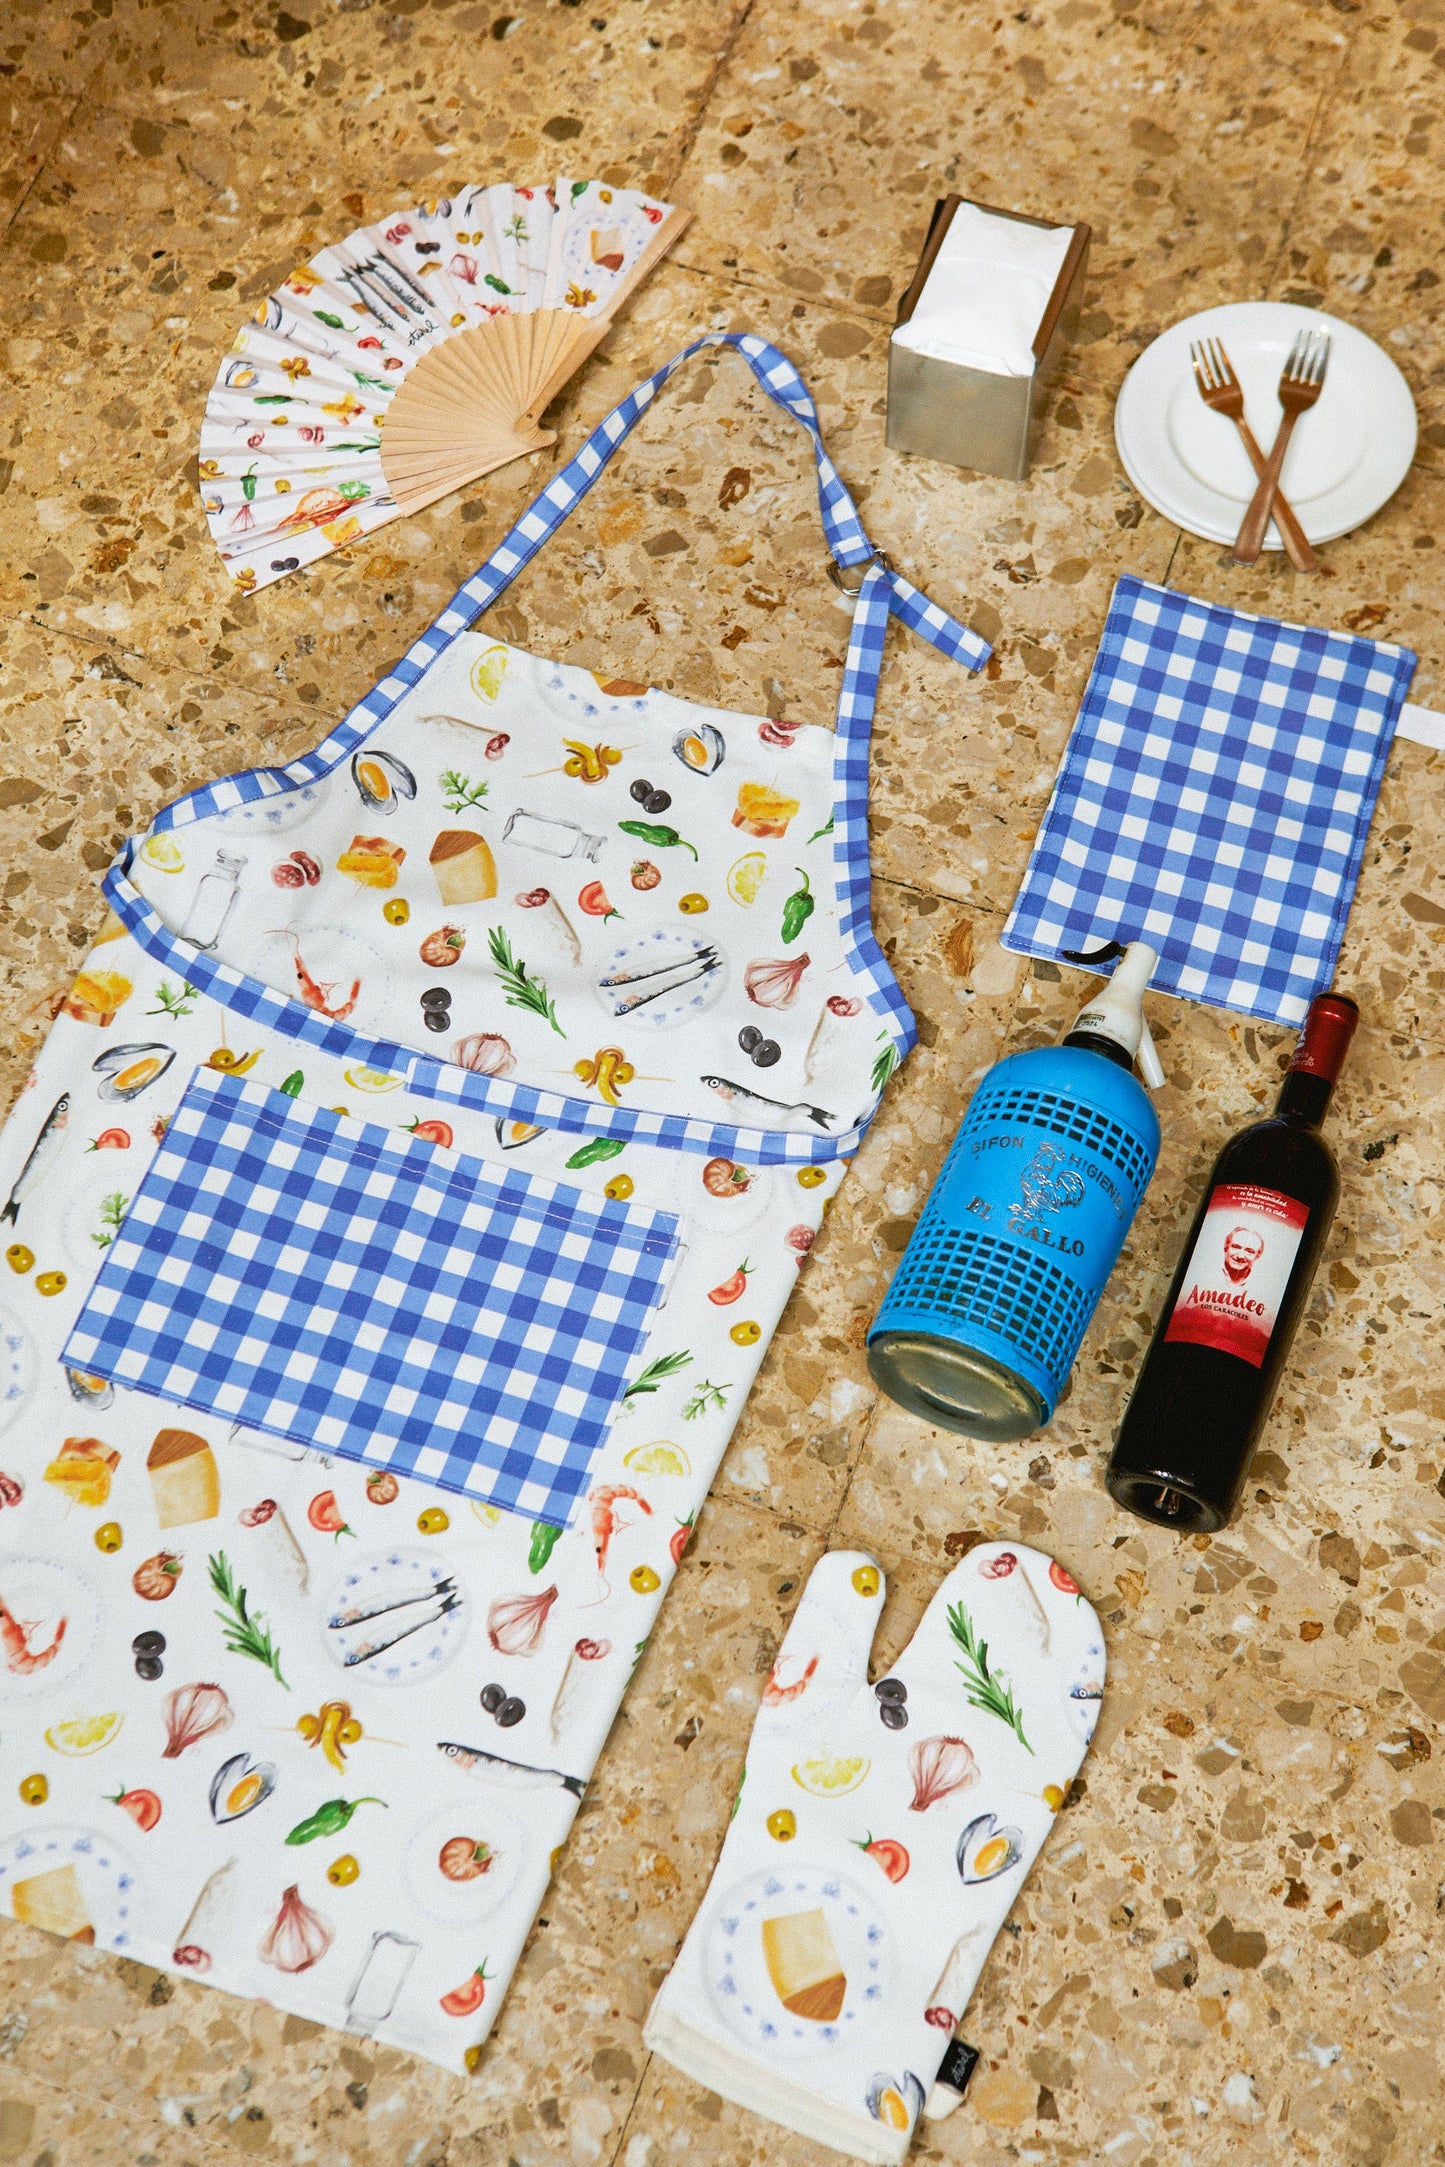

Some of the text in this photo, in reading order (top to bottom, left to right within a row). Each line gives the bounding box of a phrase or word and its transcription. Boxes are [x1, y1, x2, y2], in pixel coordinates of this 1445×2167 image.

[971, 1135, 1025, 1154] SIFON
[965, 1195, 1085, 1257] EL GALLO
[1186, 1284, 1266, 1316] Amadeo
[1200, 1303, 1249, 1321] LOS CARACOLES
